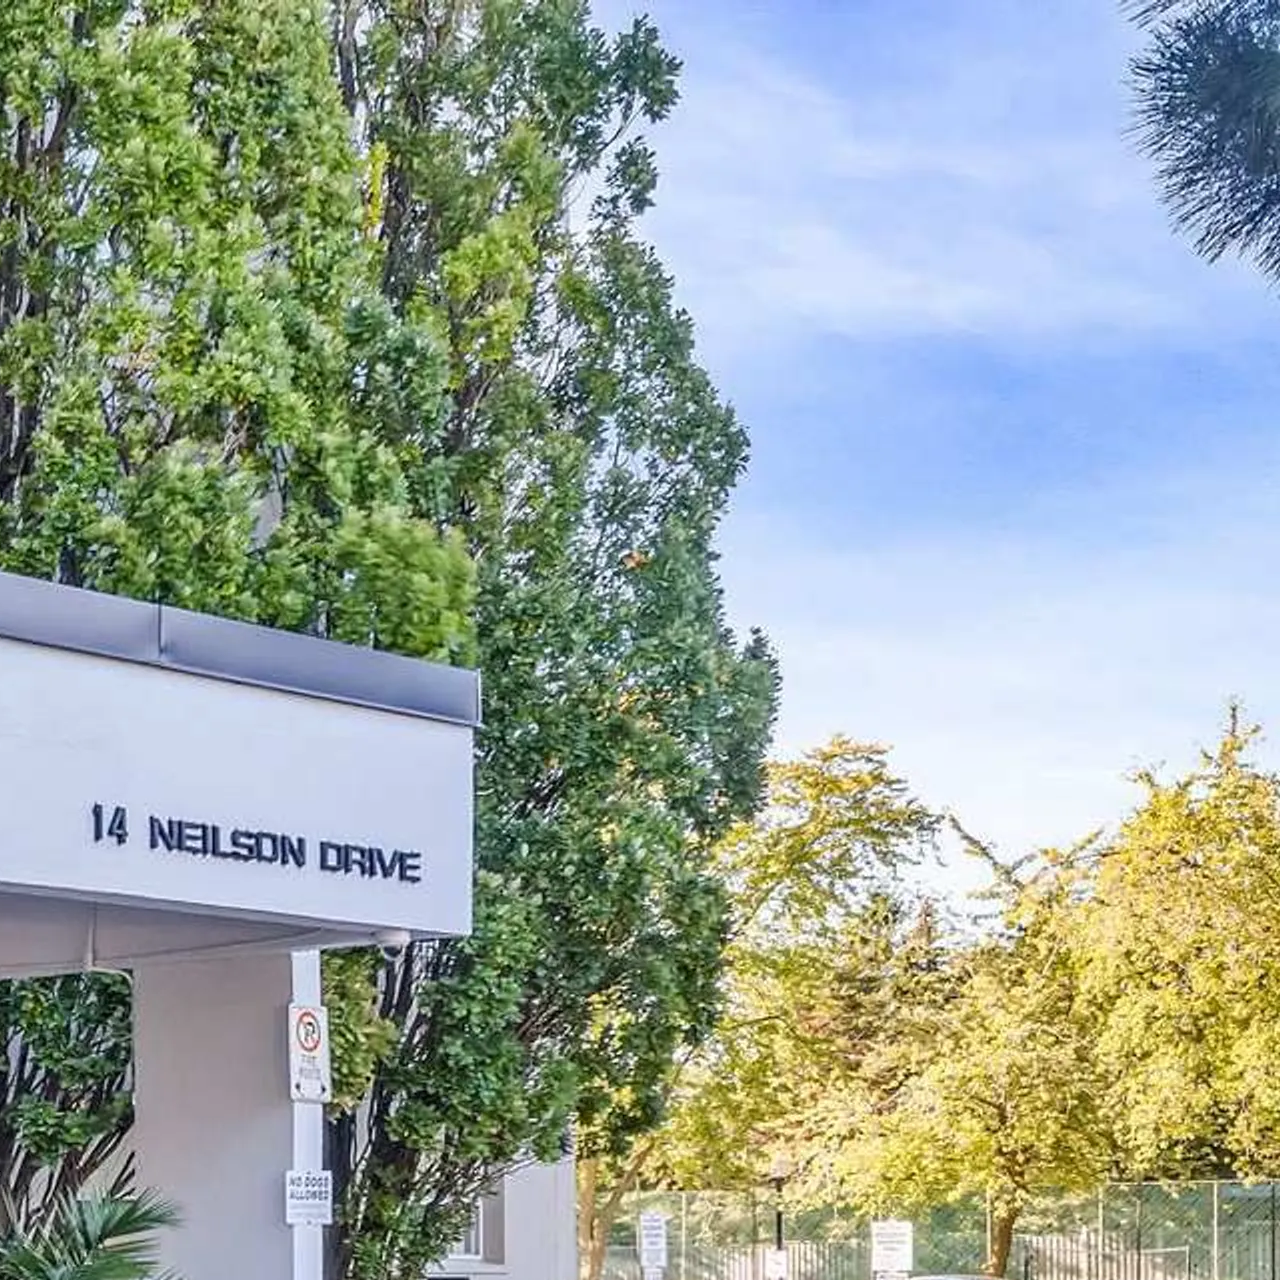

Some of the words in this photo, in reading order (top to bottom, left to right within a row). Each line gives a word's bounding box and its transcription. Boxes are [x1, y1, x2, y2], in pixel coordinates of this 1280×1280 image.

[91, 801, 129, 846] 14
[148, 814, 307, 869] NEILSON
[319, 839, 422, 884] DRIVE
